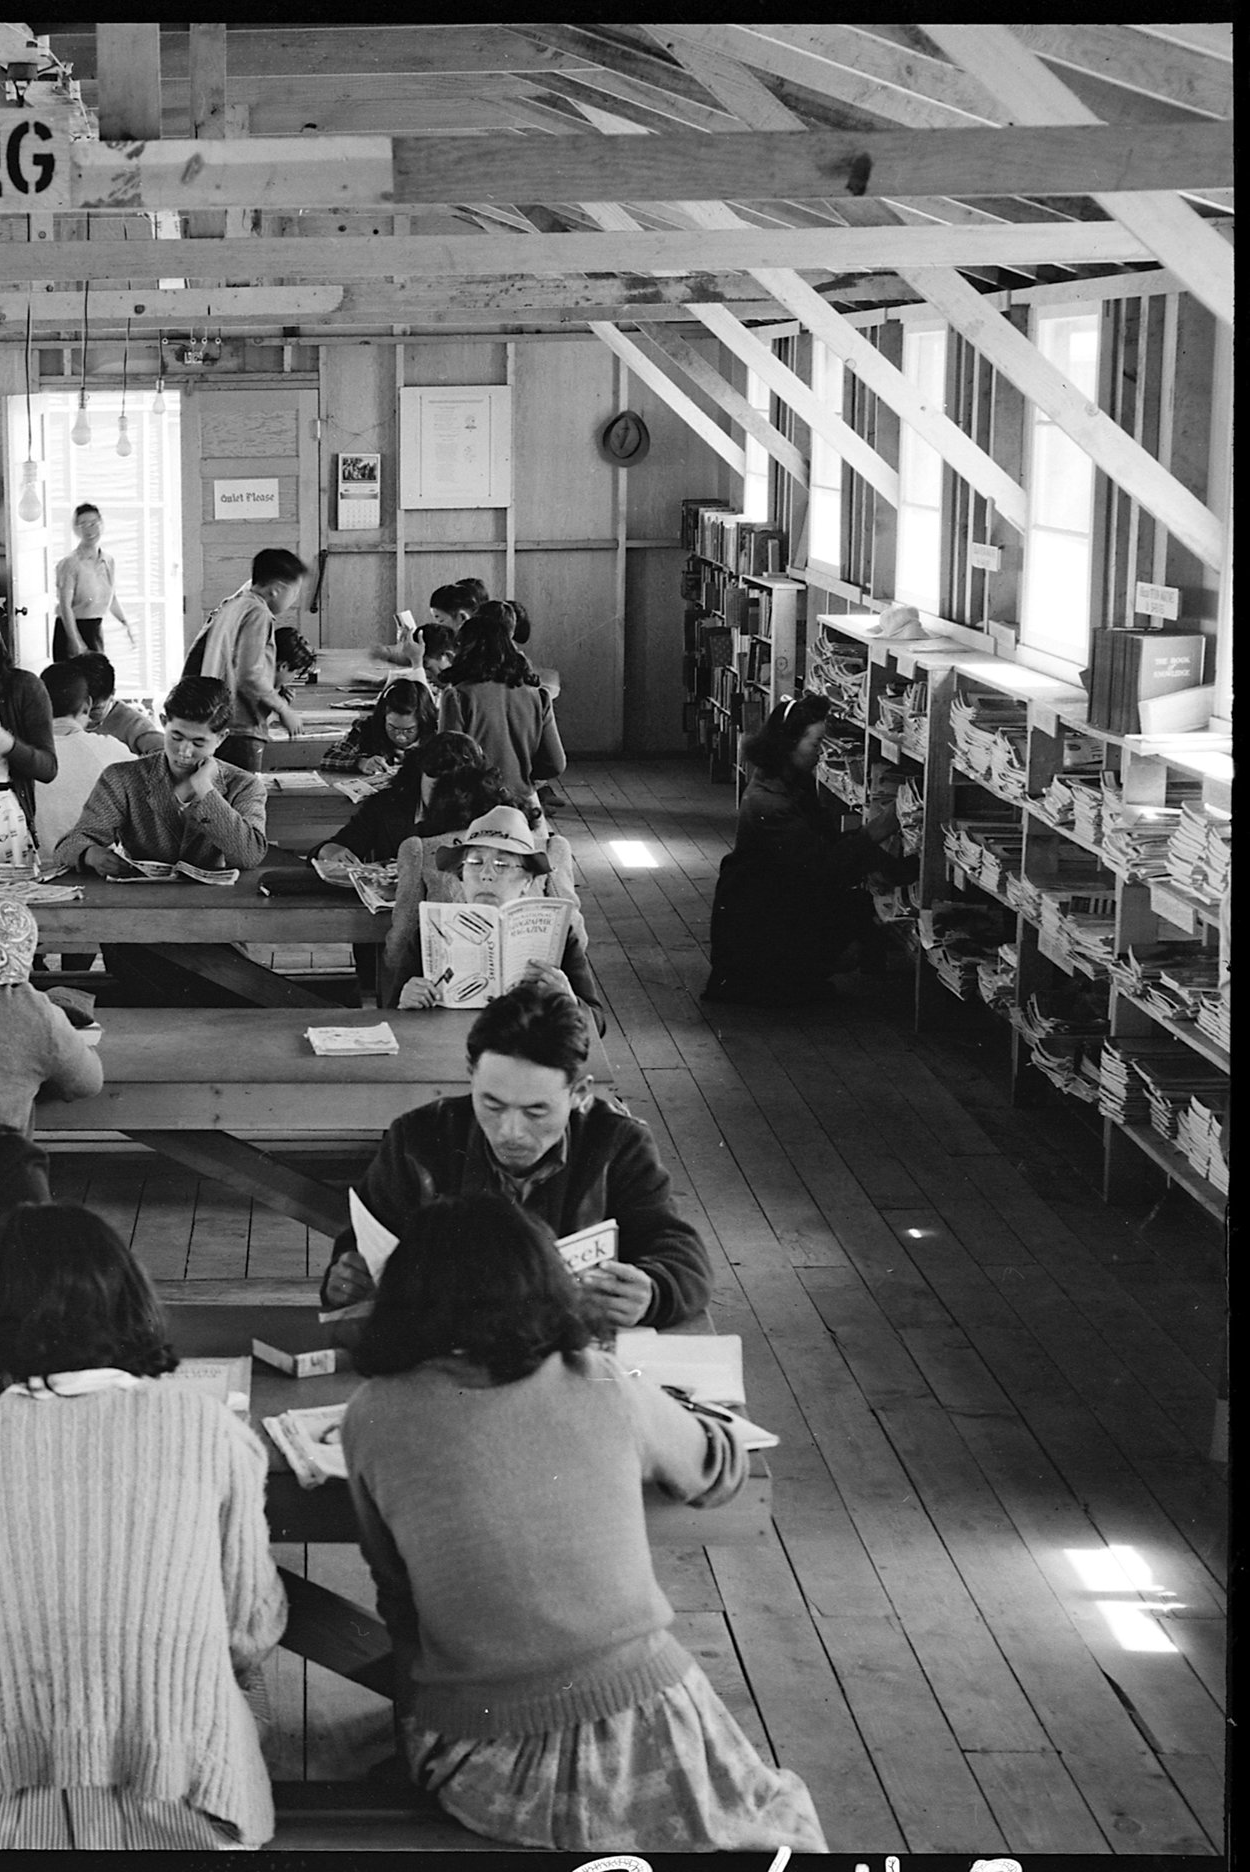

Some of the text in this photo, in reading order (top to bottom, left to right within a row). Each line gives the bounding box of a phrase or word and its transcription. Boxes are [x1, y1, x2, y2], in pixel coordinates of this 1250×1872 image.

[220, 491, 275, 503] Quiet Please
[1170, 656, 1191, 664] BOOK
